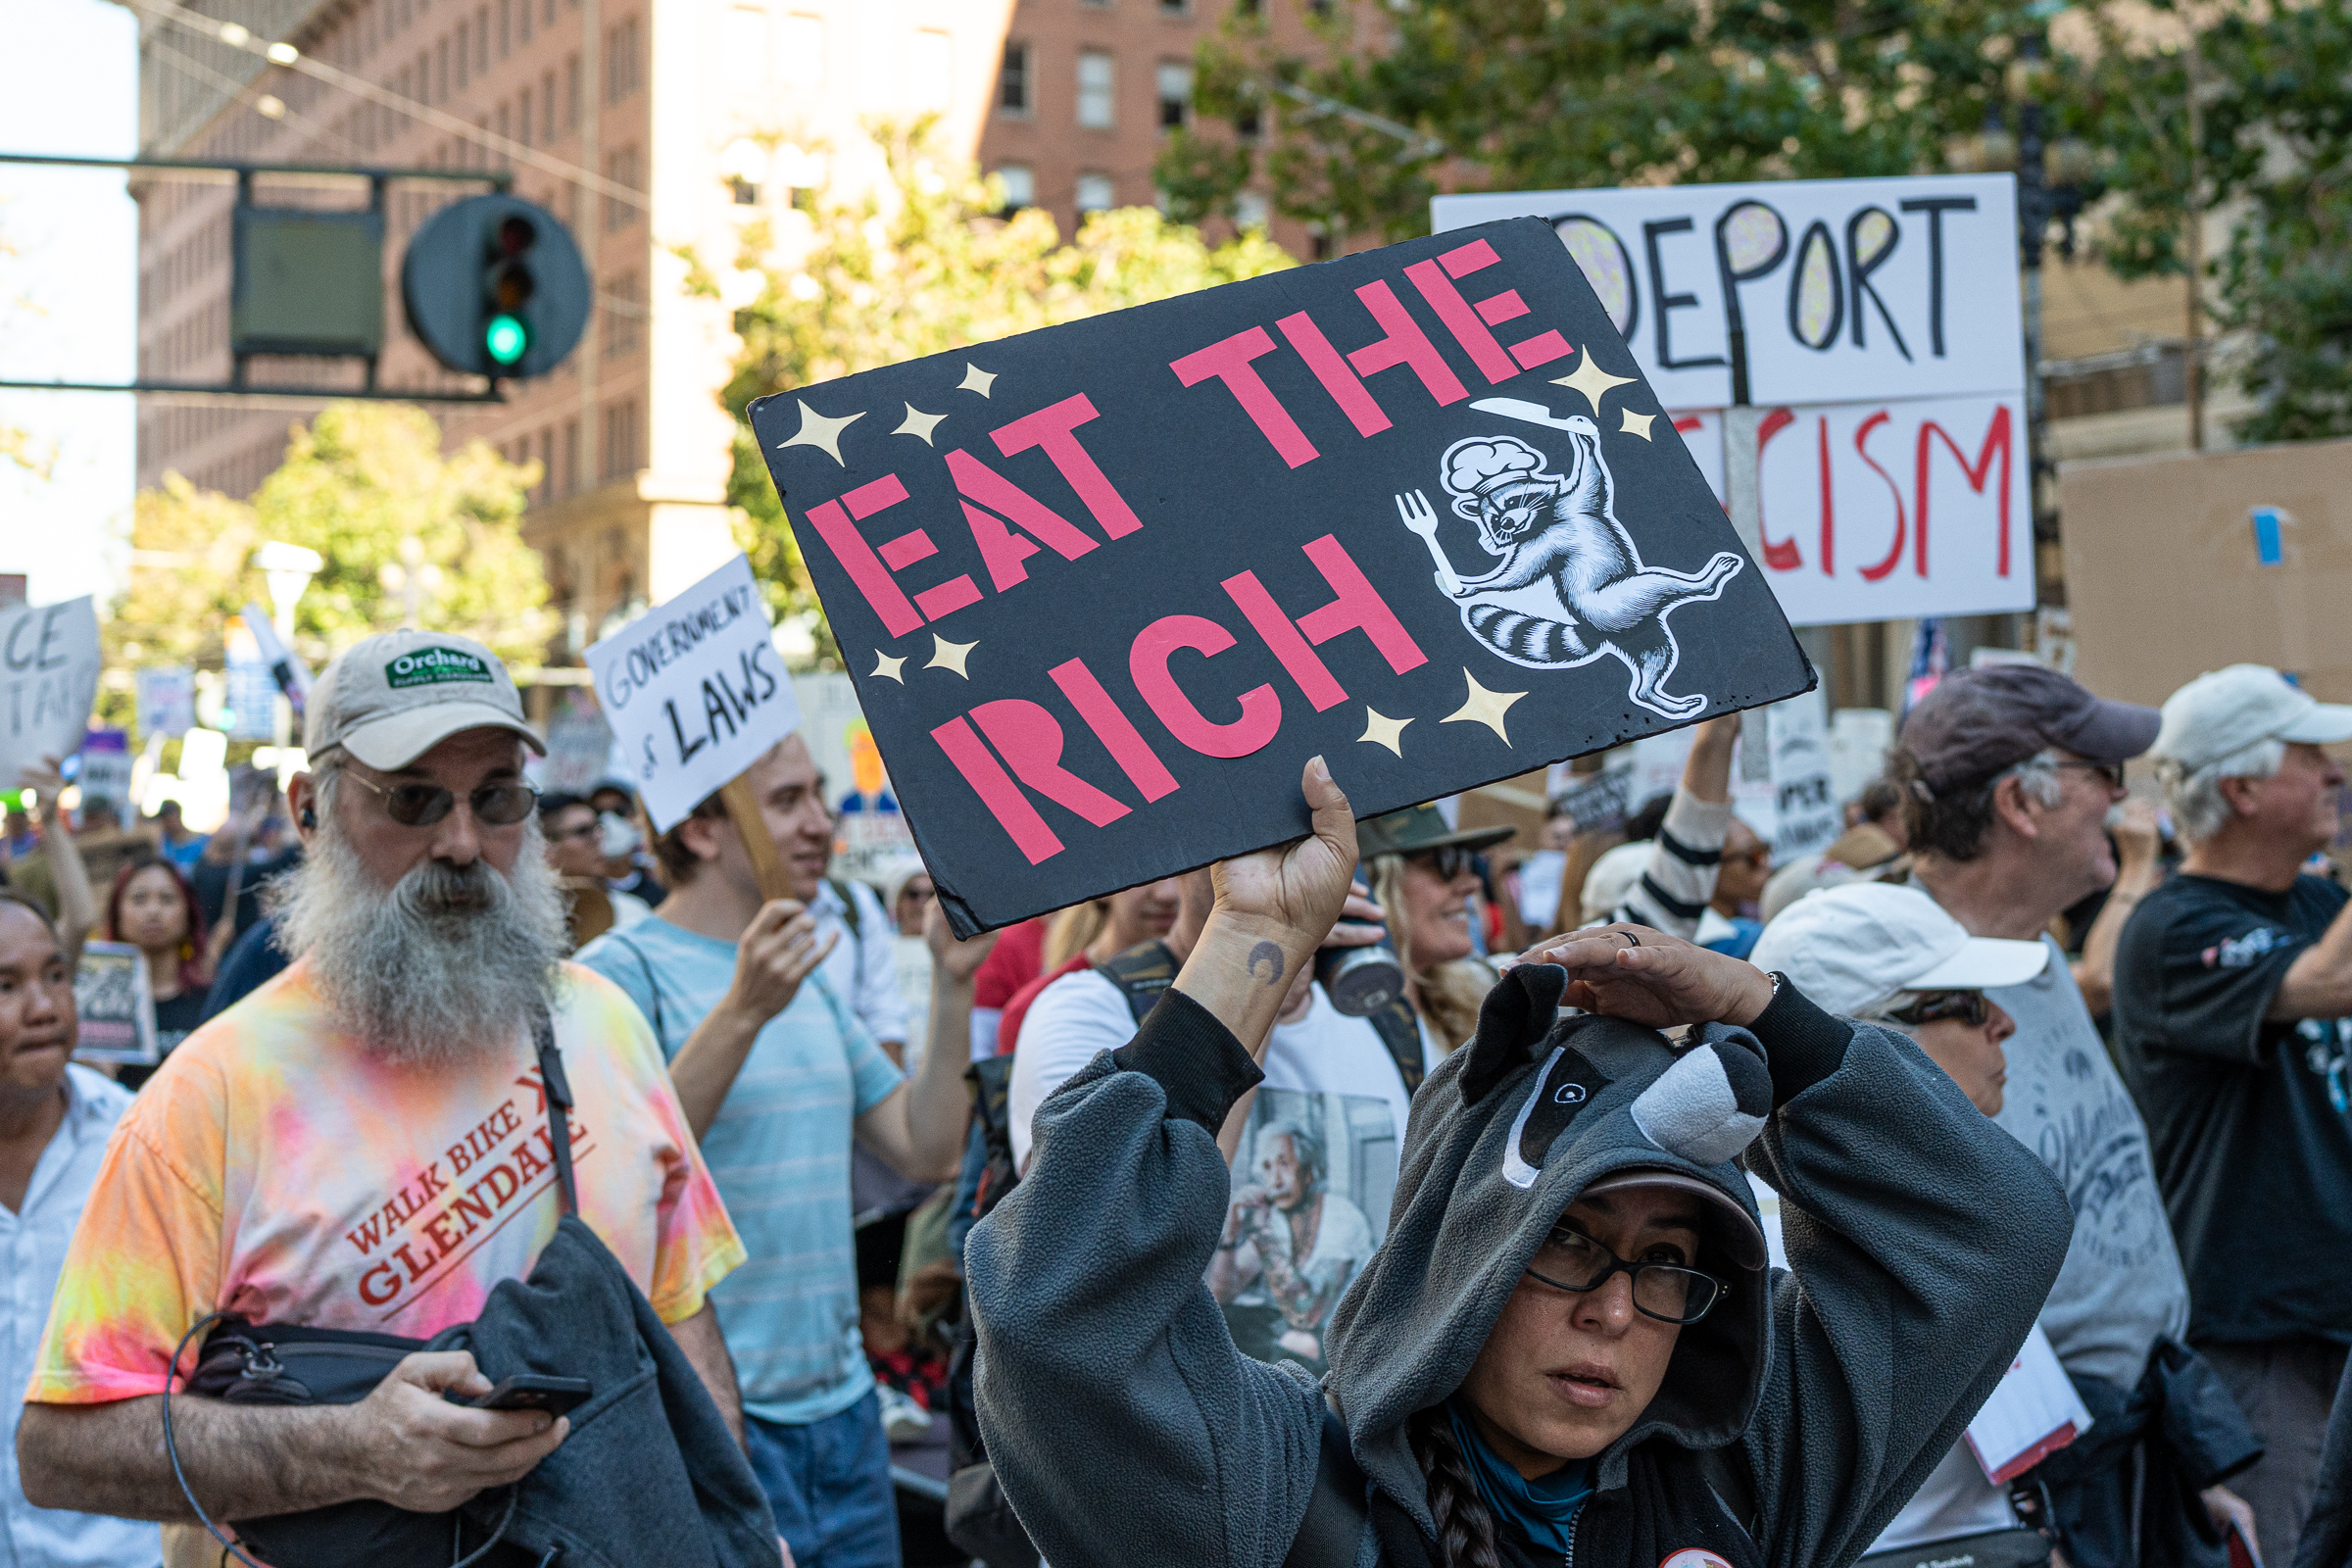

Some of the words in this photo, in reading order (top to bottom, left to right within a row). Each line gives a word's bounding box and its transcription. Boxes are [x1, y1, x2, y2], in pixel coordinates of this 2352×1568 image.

[805, 392, 1144, 640] EAT
[1168, 238, 1575, 469] THE
[1672, 405, 2011, 582] CISM
[394, 648, 480, 675] Orchard
[605, 584, 750, 710] GOVERNMENT
[663, 640, 776, 764] LAWS
[929, 533, 1430, 866] RICH
[346, 1162, 449, 1256] WALK
[445, 1099, 522, 1176] BIKE
